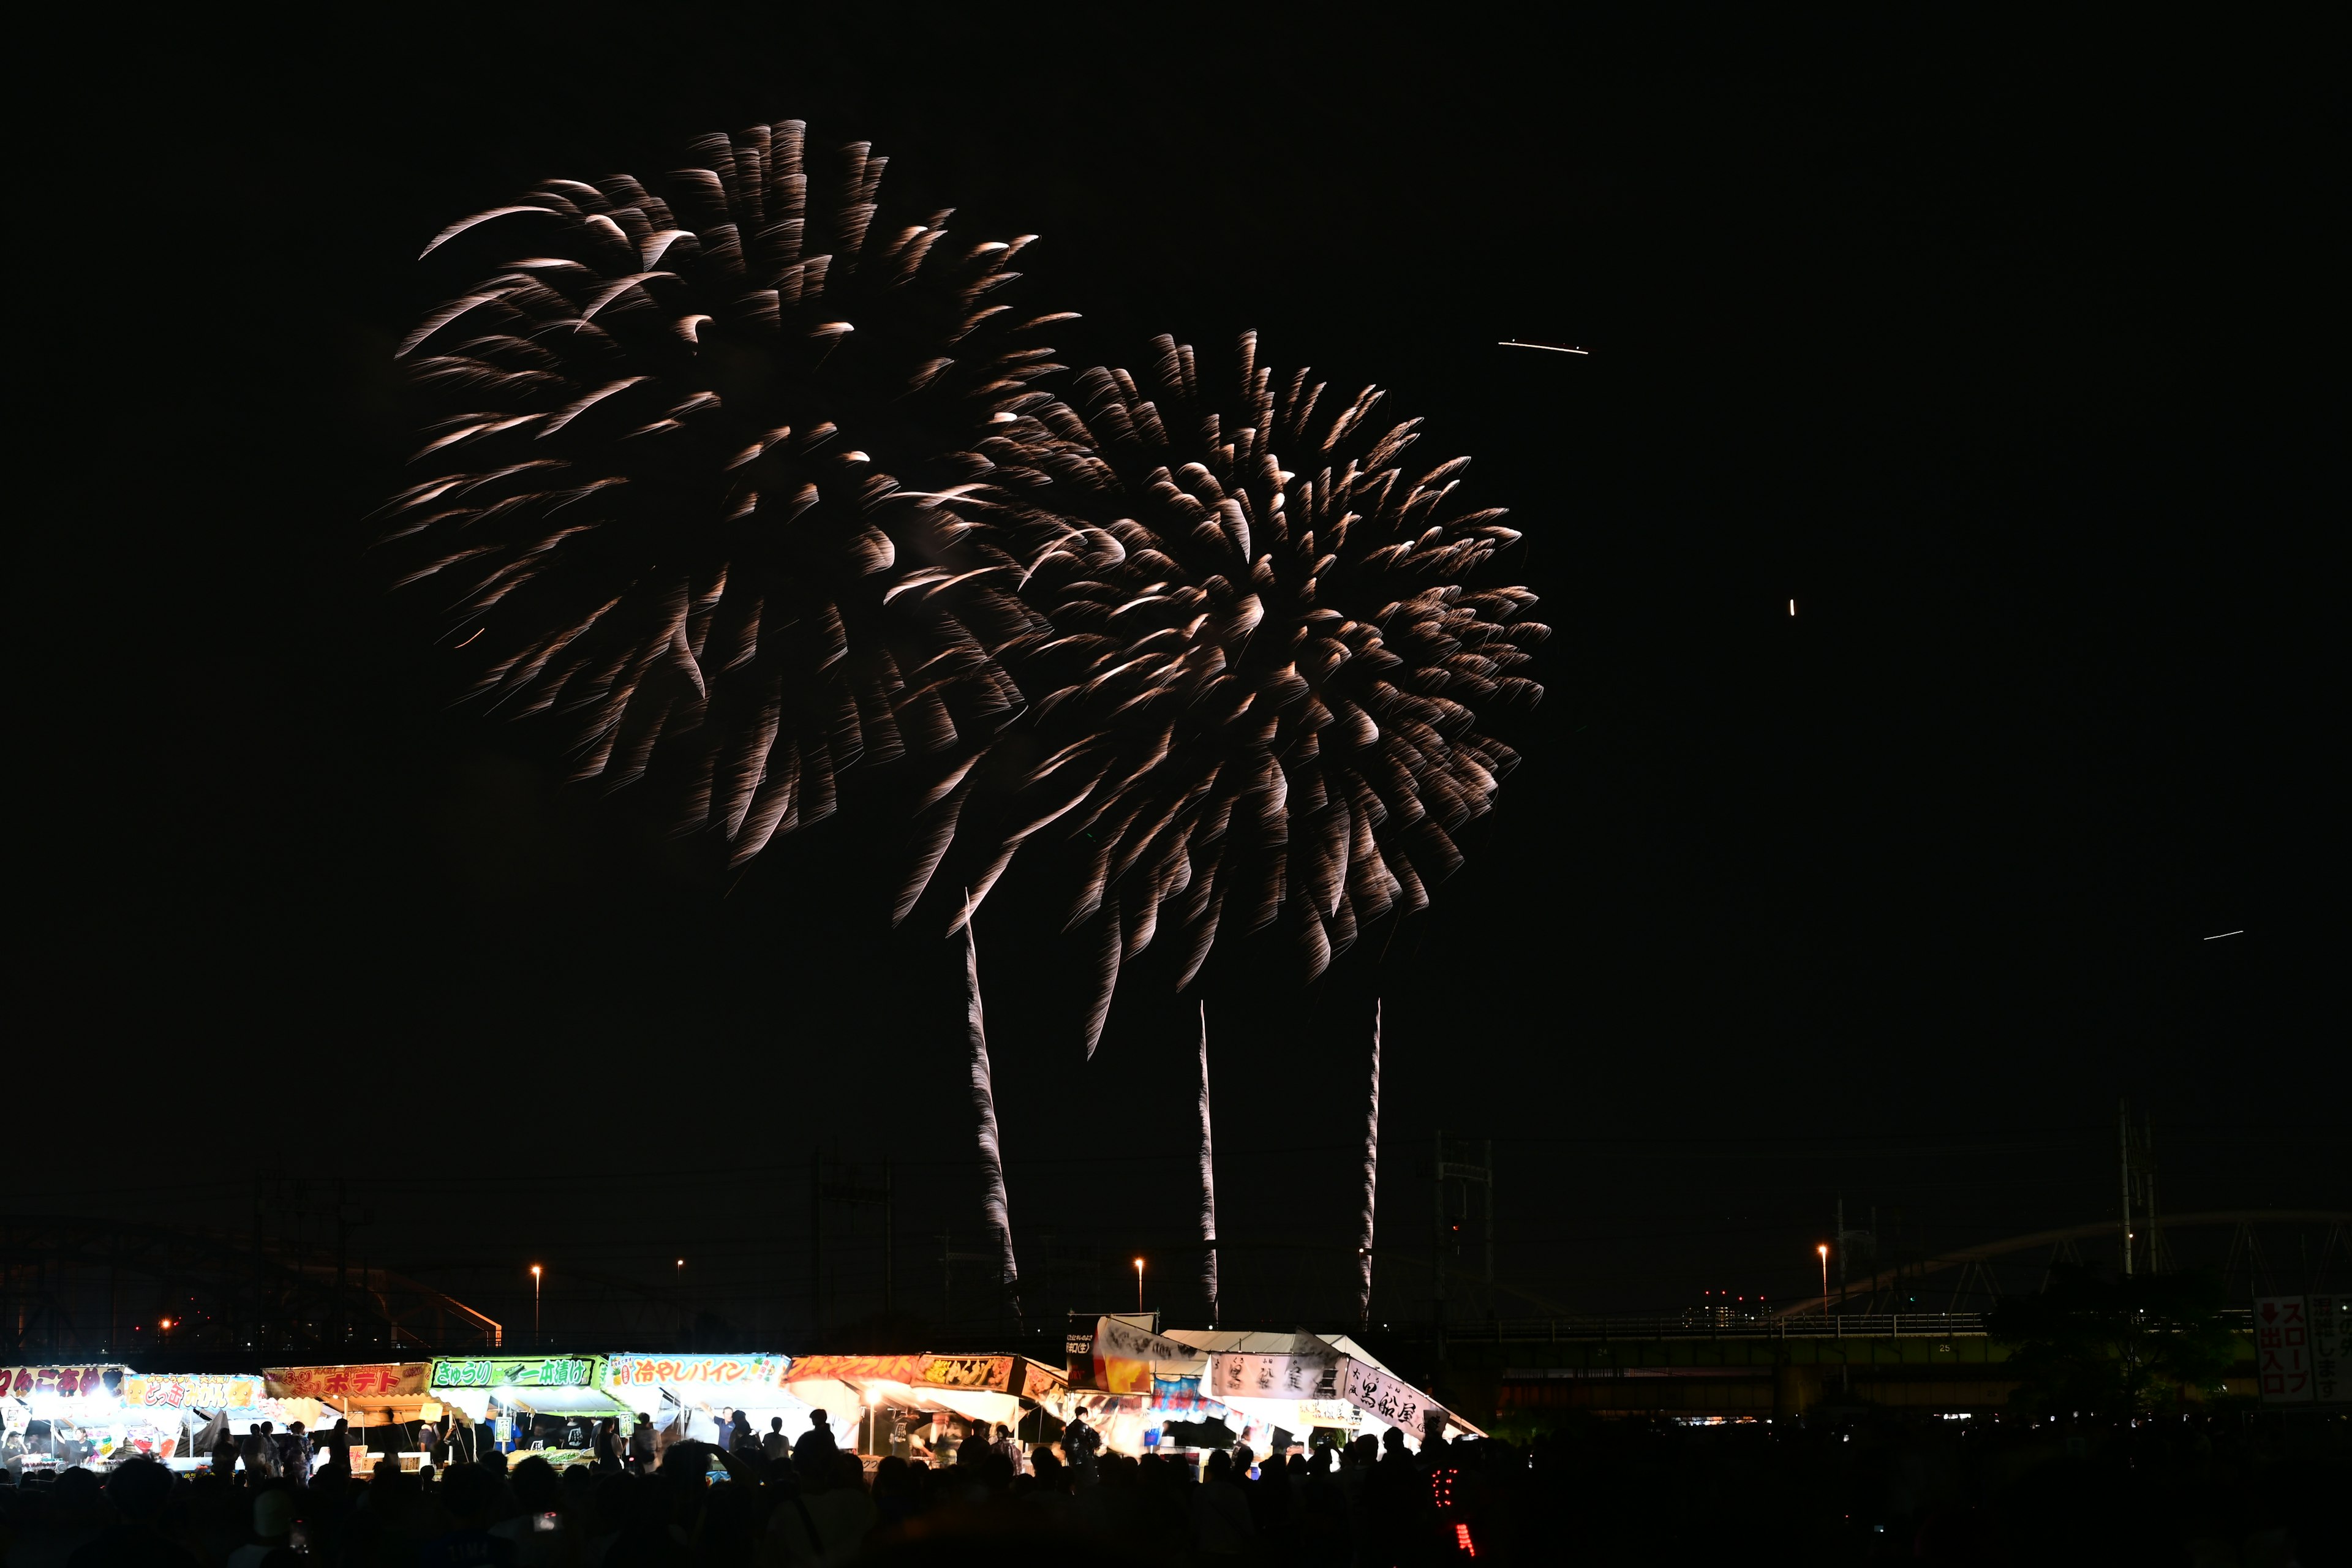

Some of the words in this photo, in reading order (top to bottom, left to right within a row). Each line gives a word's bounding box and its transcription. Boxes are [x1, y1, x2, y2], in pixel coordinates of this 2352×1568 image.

[437, 1361, 492, 1385] きゅうり
[519, 1359, 586, 1385] 一本漬け
[634, 1359, 747, 1383] 冷やしパイン
[2260, 1327, 2285, 1393] 出入口
[2283, 1303, 2309, 1393] スロープ
[2313, 1298, 2337, 1398] 混雑します
[322, 1371, 400, 1395] ポテト
[1360, 1379, 1417, 1428] 黒船屋
